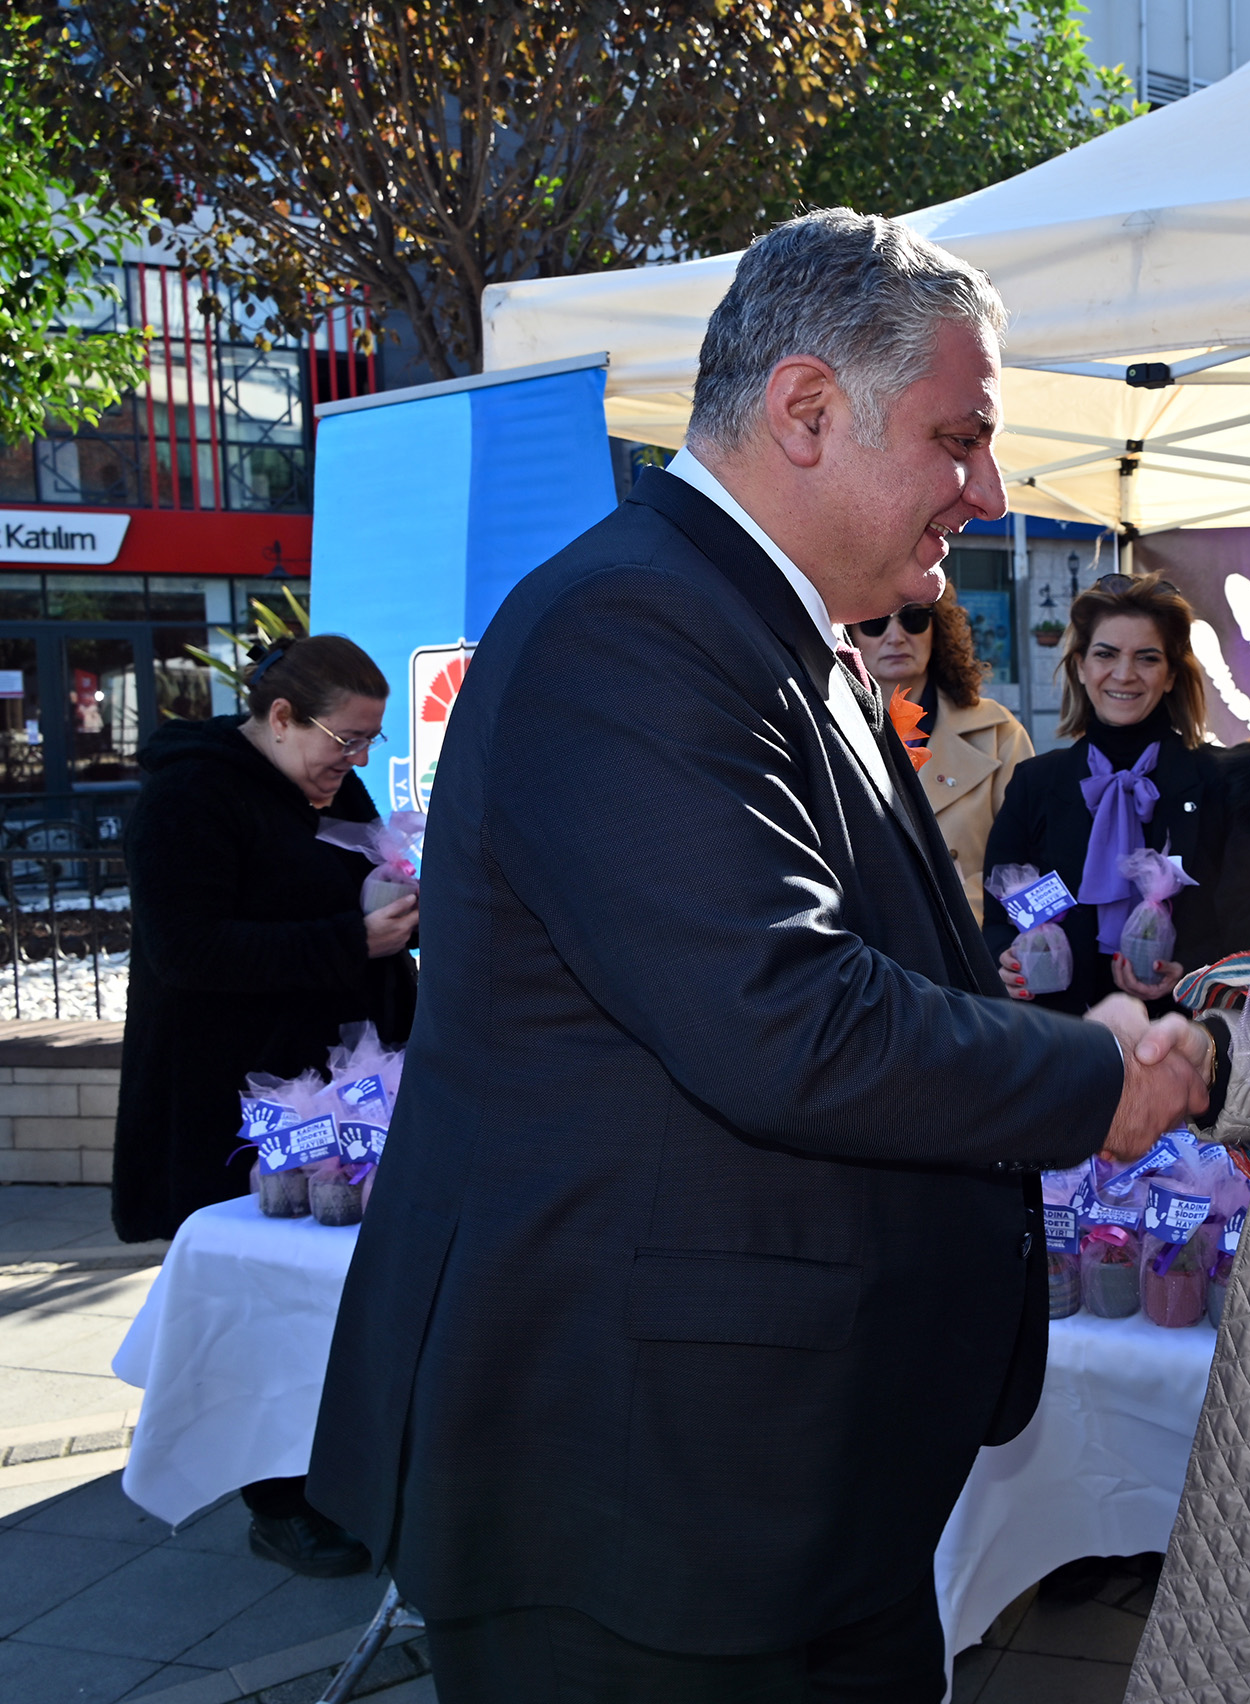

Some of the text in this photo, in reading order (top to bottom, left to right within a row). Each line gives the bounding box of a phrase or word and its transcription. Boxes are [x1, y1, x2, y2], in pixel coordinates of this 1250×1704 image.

[5, 523, 97, 551] Katılım
[1177, 1201, 1207, 1211] KADINA
[1043, 1210, 1069, 1219] ADINA
